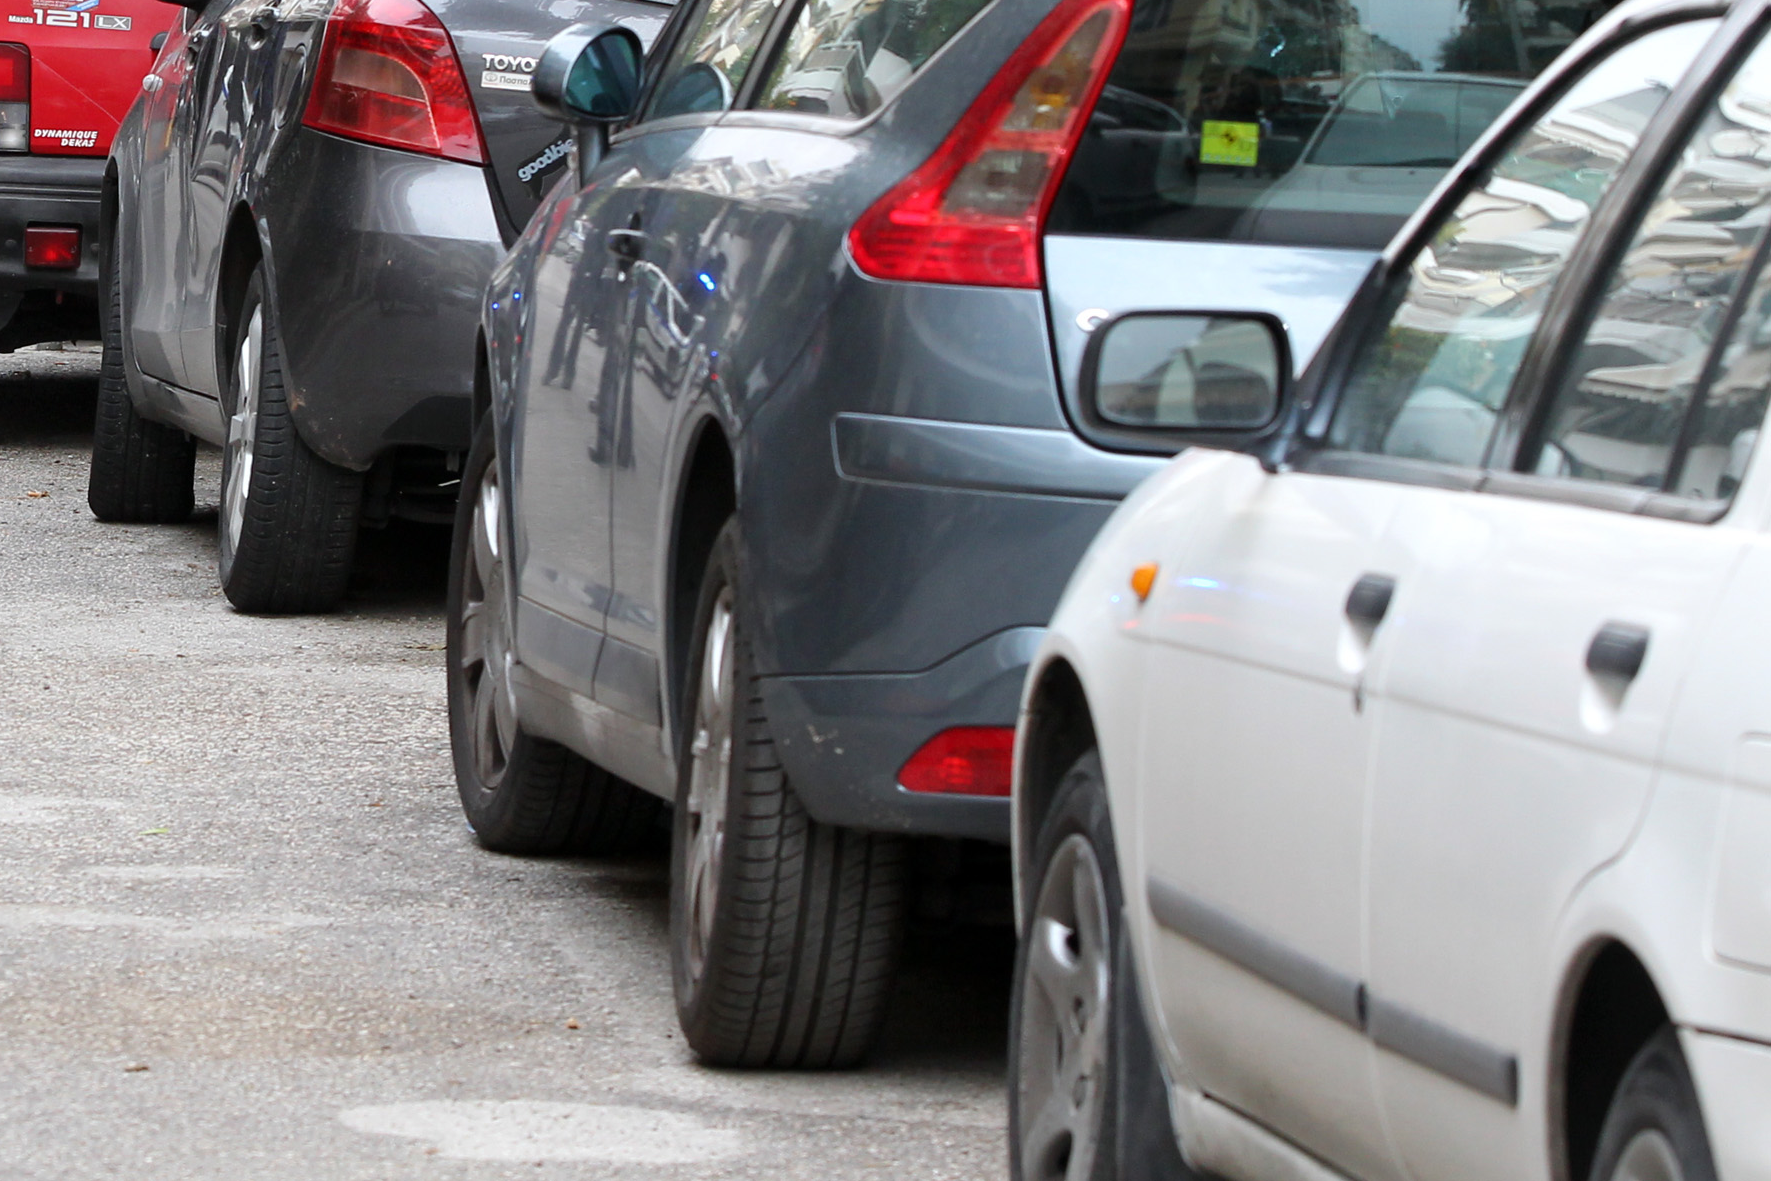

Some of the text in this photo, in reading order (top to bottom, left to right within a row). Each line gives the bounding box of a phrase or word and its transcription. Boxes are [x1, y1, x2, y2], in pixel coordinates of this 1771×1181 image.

[8, 8, 127, 29] Mazda 121 LX
[34, 129, 98, 139] DYNAMIQUE
[61, 138, 95, 147] DEKAS
